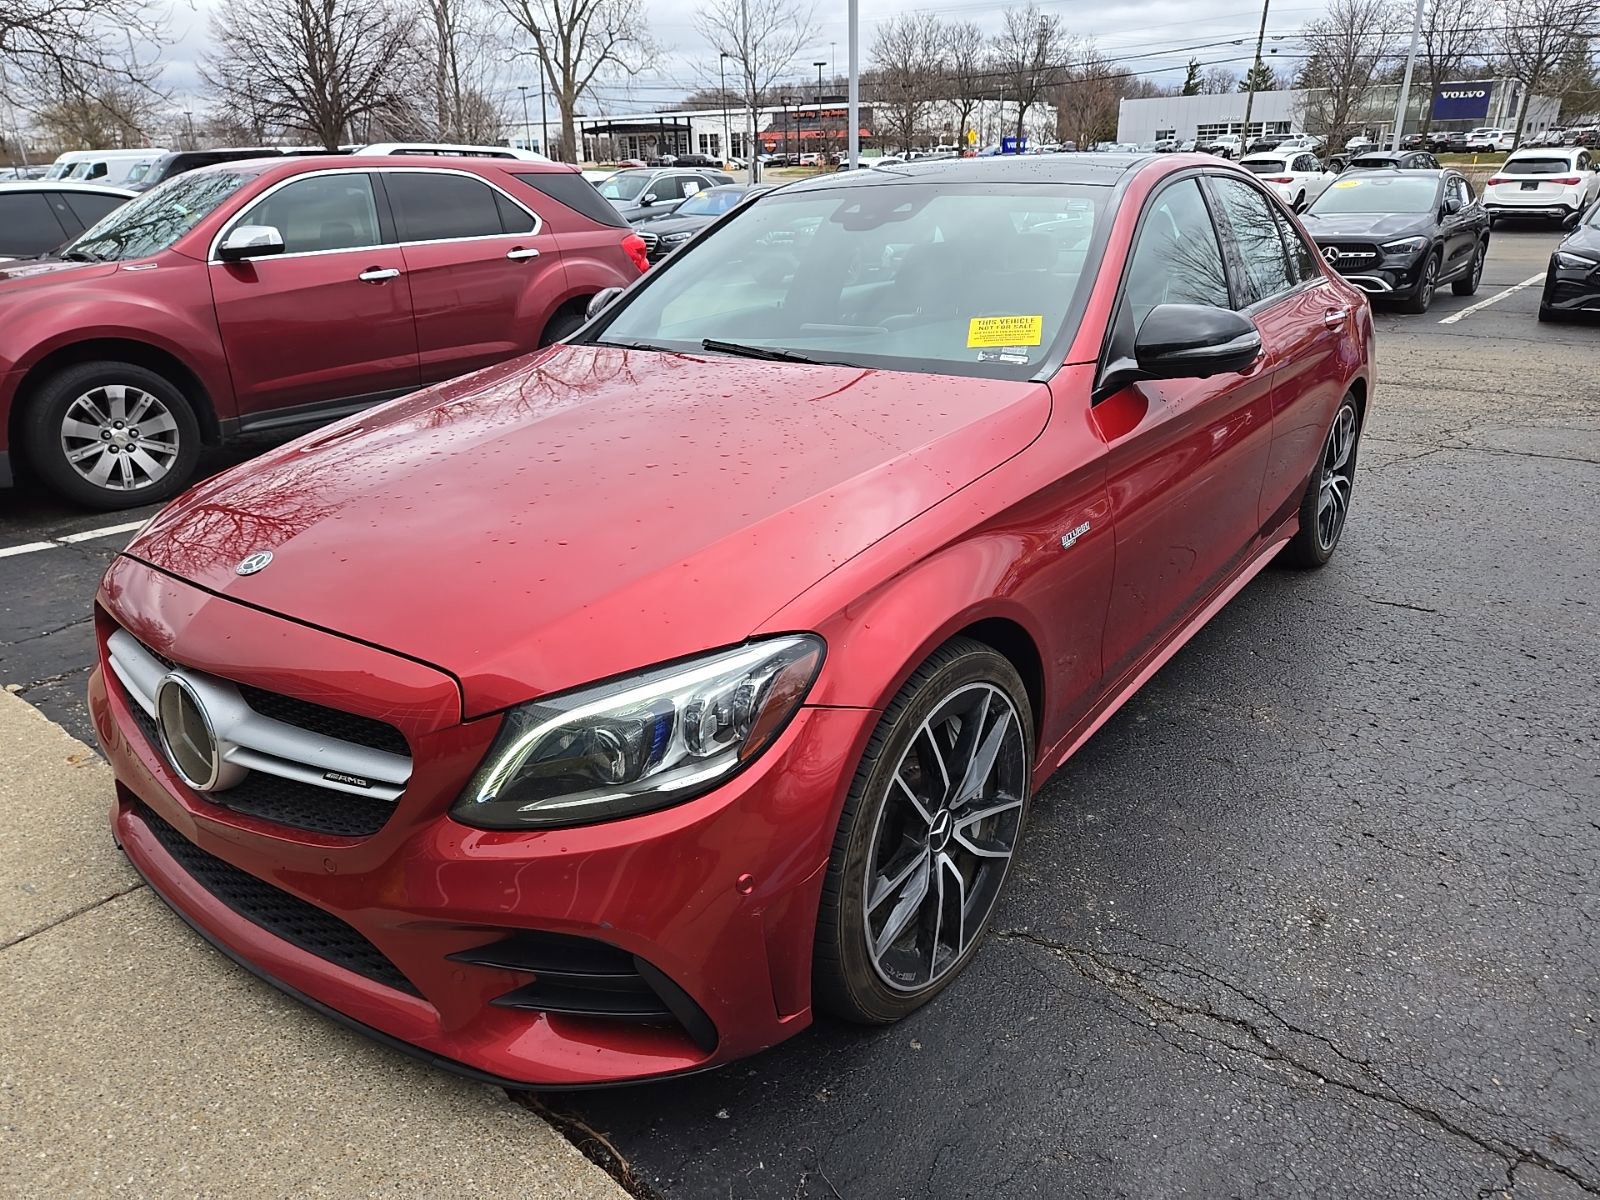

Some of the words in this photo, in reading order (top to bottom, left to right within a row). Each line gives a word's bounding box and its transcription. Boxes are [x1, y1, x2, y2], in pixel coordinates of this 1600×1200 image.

[1441, 90, 1486, 99] VOLVO
[1000, 317, 1035, 325] VEHICLE
[338, 774, 367, 786] AMG
